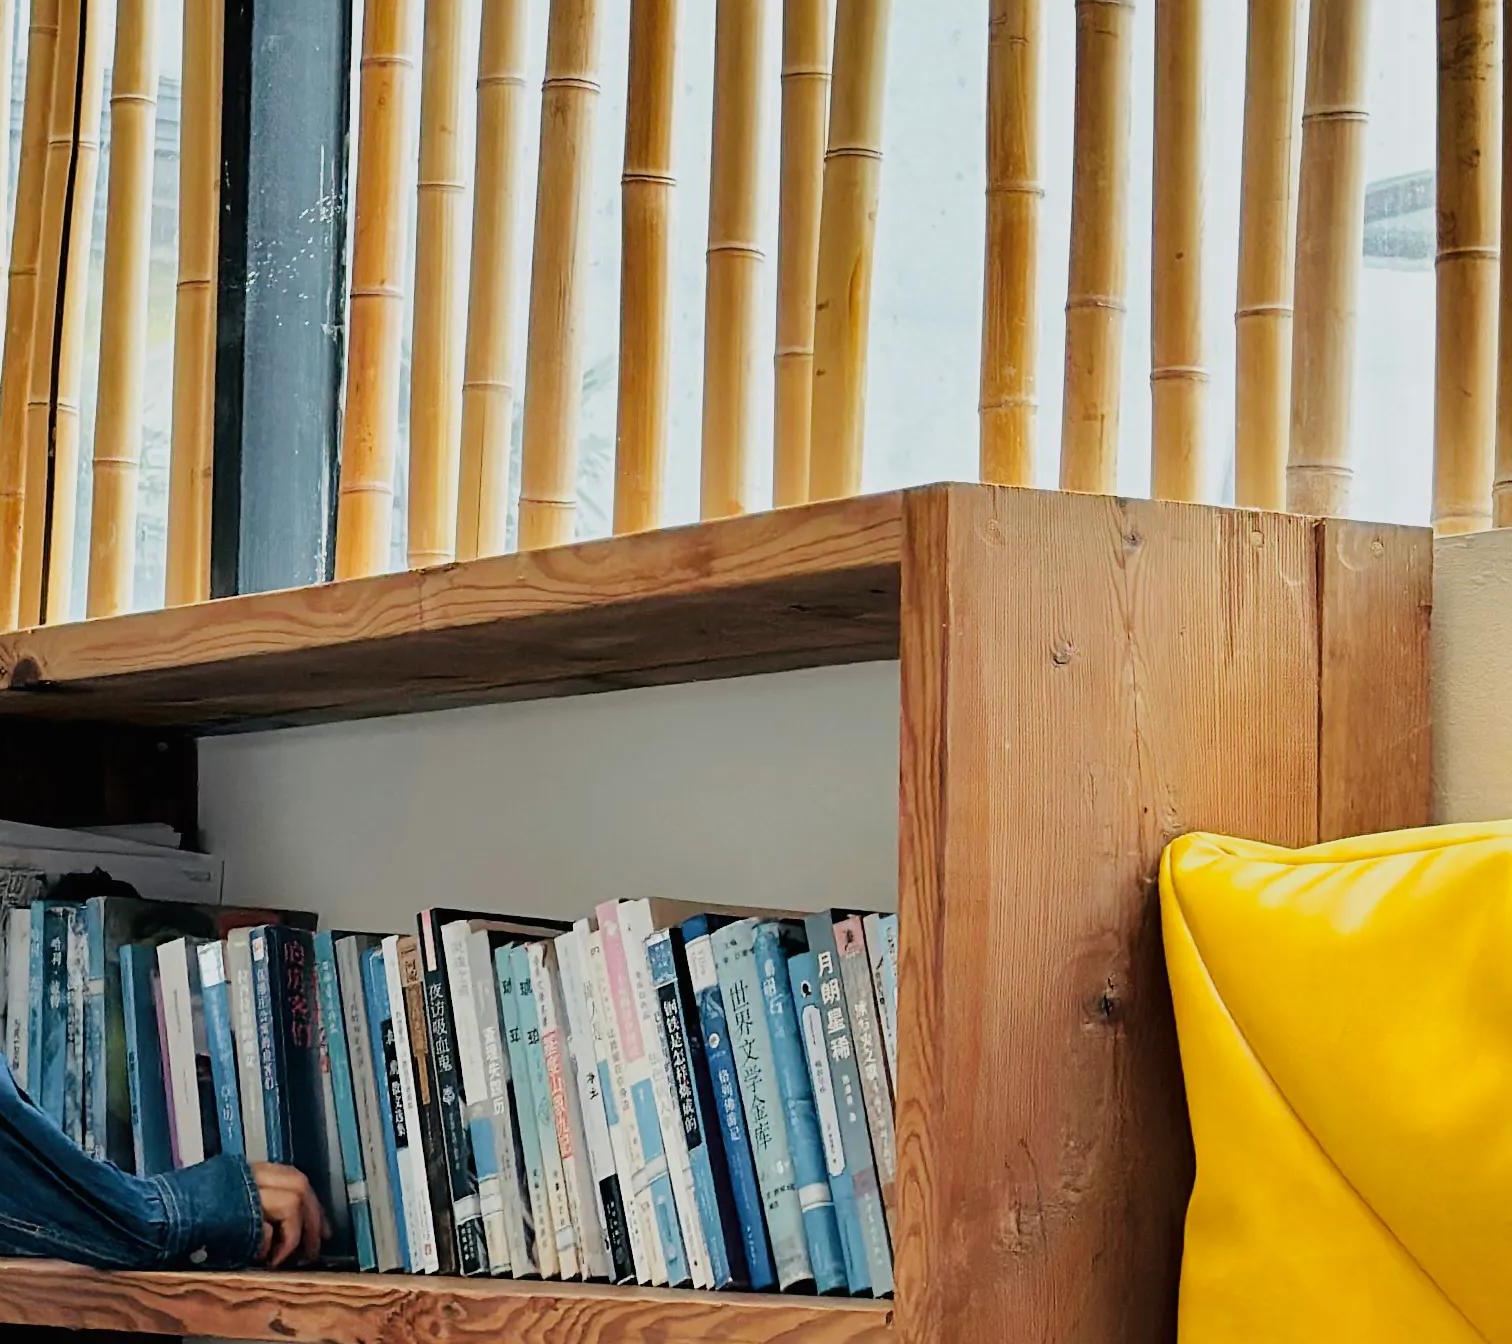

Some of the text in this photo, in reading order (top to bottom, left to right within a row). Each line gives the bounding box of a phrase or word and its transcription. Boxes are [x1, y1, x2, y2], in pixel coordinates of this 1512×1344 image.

[428, 982, 453, 1074] 夜访吸血鬼
[663, 998, 697, 1133] 钢铁是怎样炼成的
[729, 979, 773, 1151] 世界文学金库
[818, 951, 851, 1062] 月朗星稀
